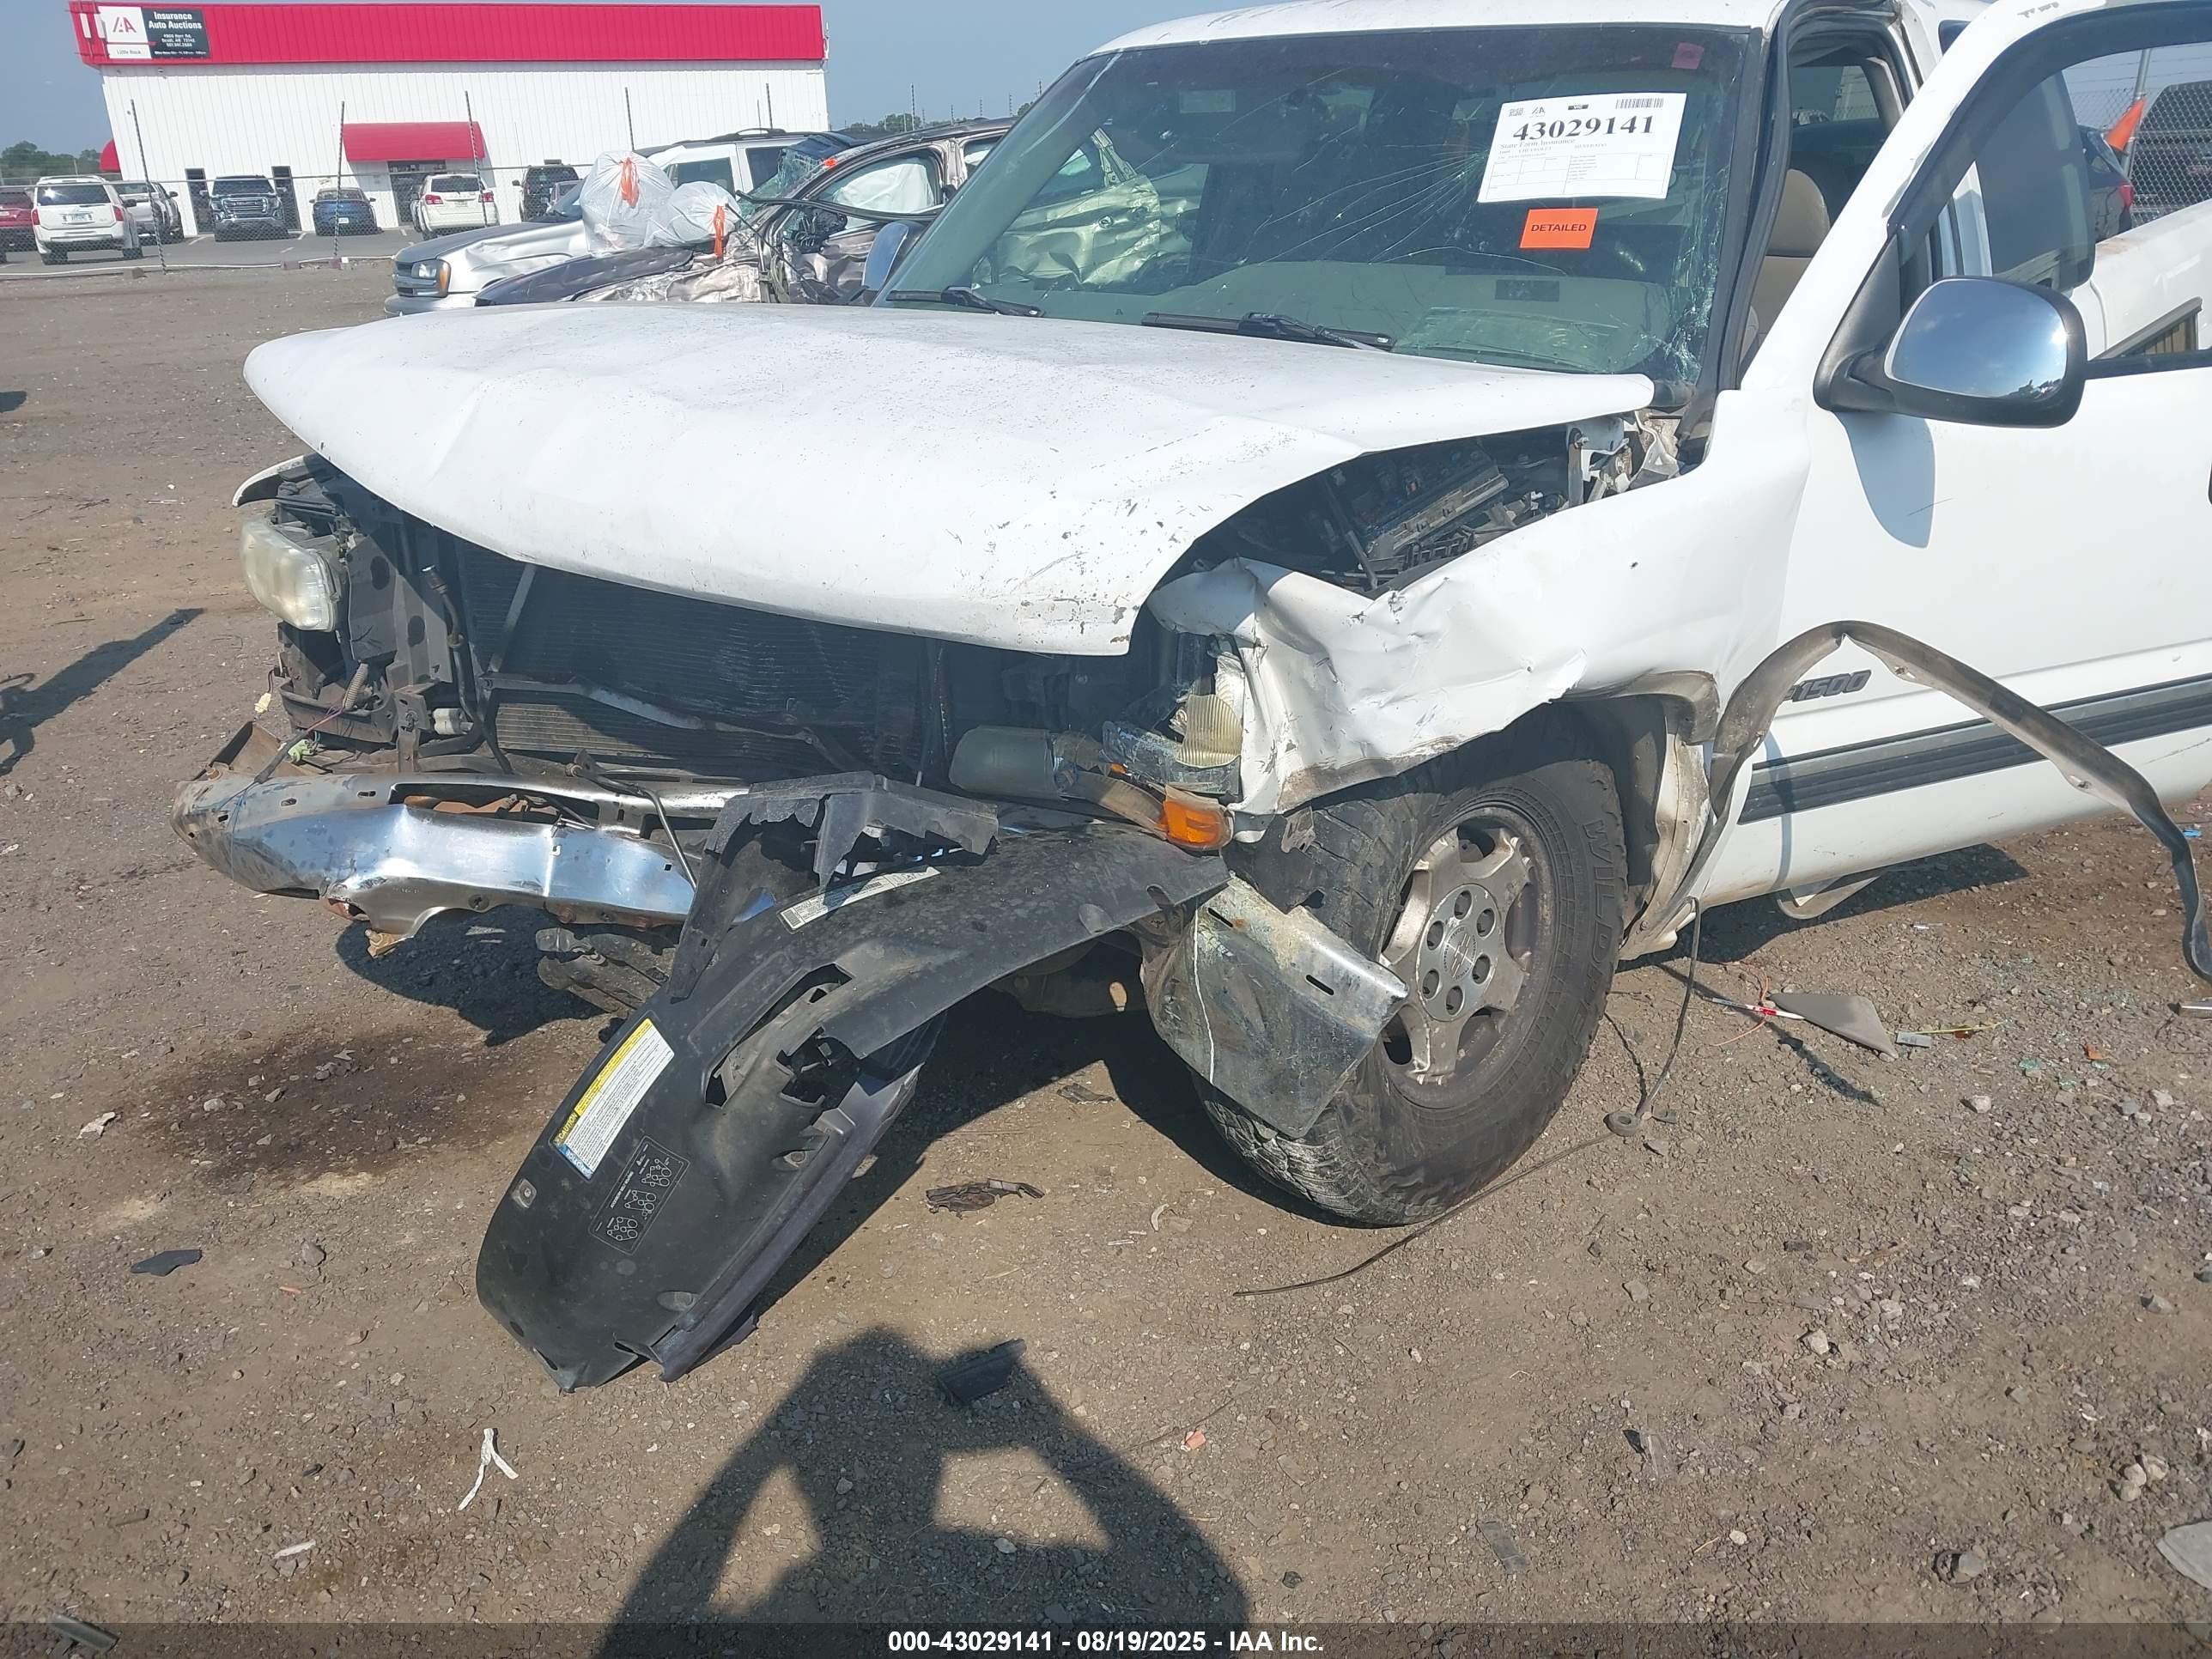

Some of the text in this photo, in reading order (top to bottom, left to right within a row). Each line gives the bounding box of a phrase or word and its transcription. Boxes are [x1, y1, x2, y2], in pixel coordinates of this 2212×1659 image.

[154, 11, 192, 20] Insurance
[149, 21, 203, 29] Auto Auctions
[1513, 115, 1654, 141] 43029141
[1531, 223, 1588, 232] DETAILED
[1794, 671, 1871, 702] 1500
[558, 1111, 578, 1139] CAUTION
